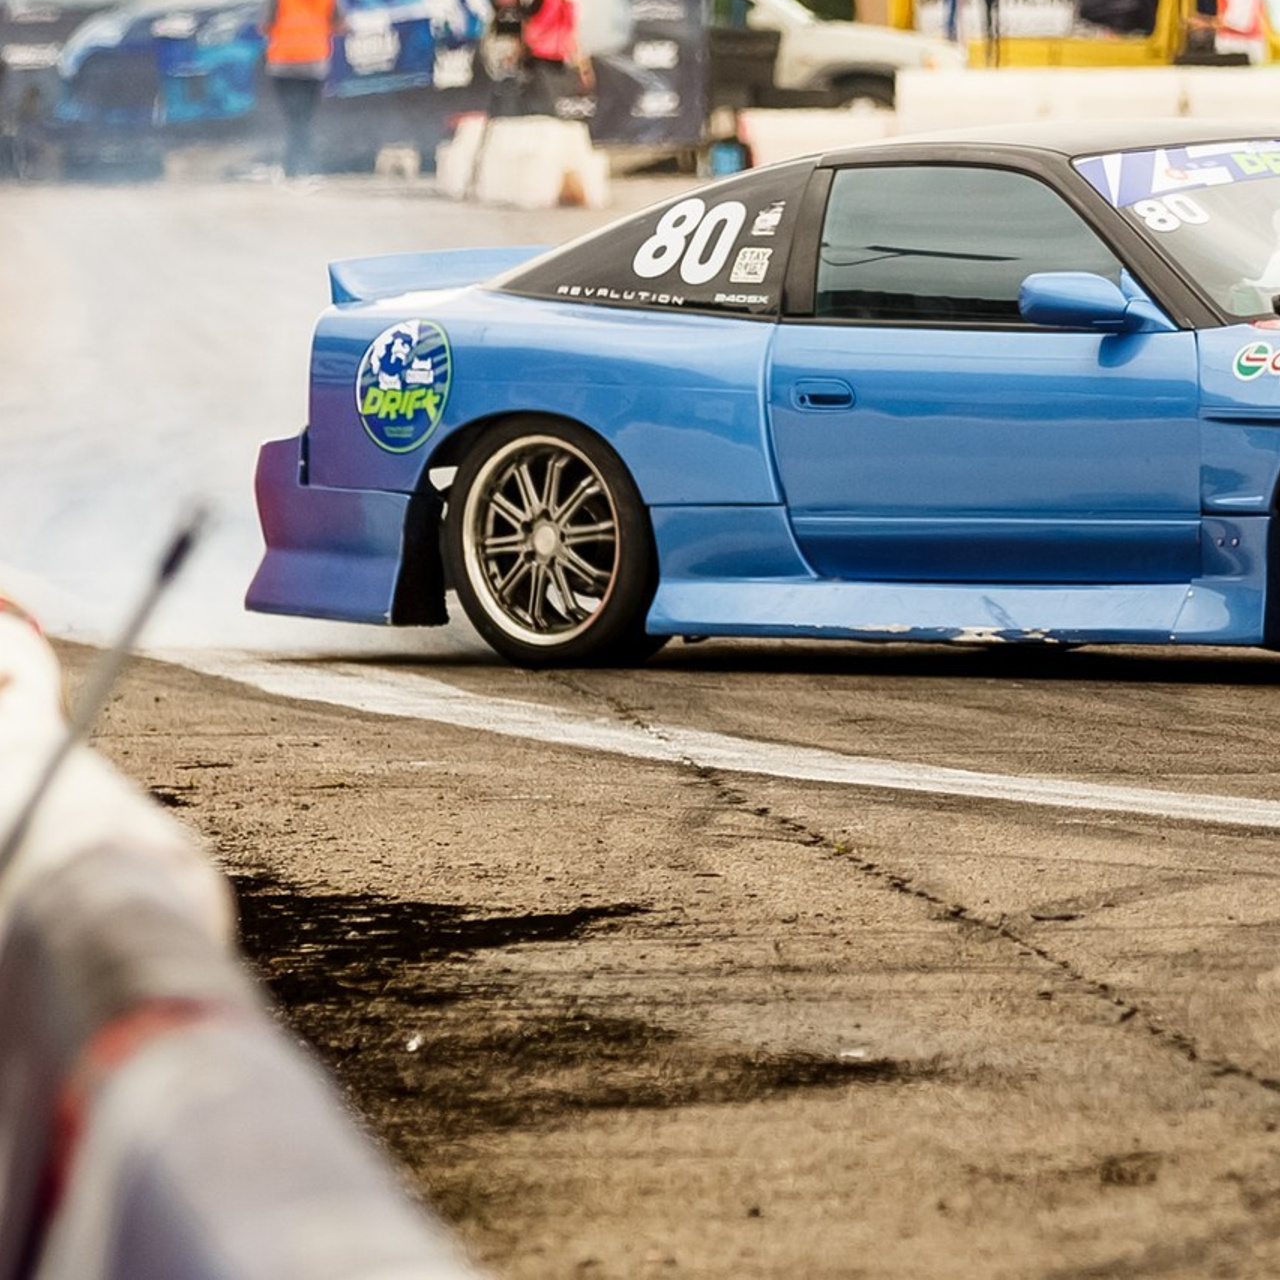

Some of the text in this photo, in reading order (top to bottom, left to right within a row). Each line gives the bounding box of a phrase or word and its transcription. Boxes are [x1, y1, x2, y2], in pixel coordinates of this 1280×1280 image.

[1133, 194, 1209, 232] 80
[633, 198, 747, 285] 80
[362, 385, 441, 423] DRIFT
